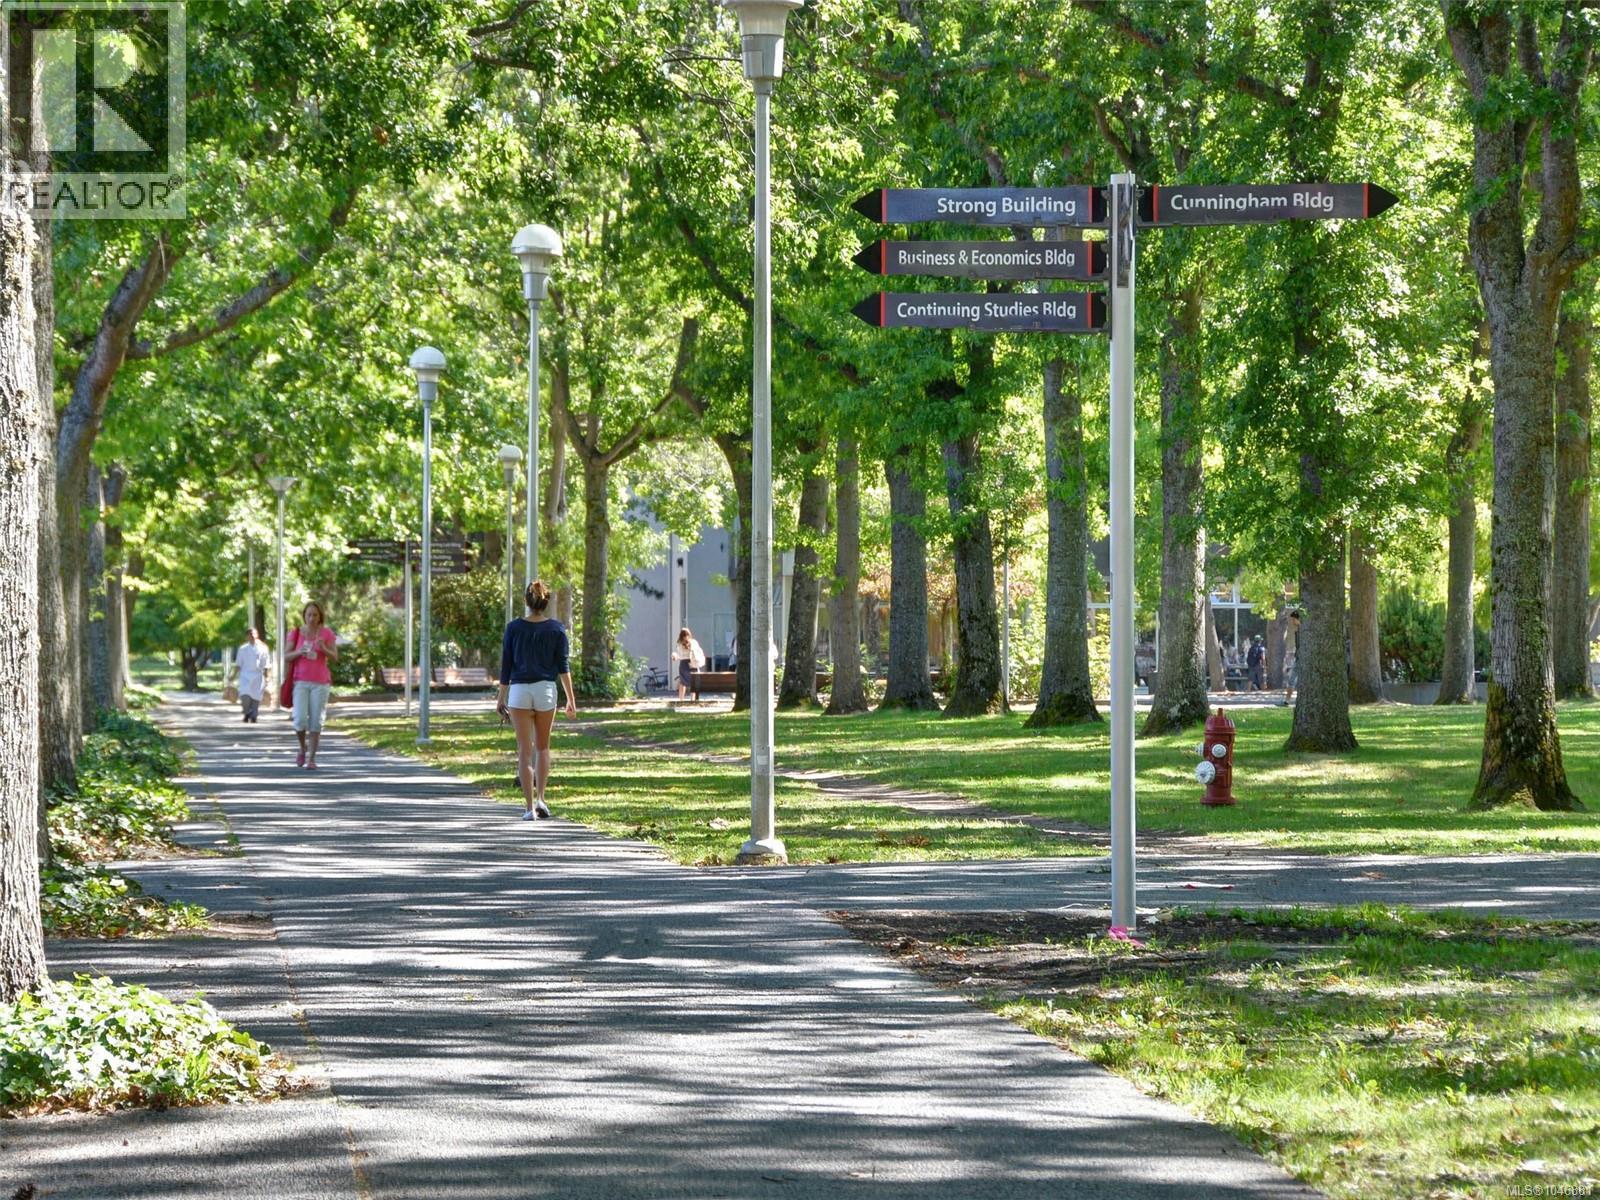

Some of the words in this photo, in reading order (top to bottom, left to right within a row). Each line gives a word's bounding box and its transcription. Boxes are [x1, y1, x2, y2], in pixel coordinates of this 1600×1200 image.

[937, 197, 997, 216] Strong
[1002, 196, 1076, 216] Building
[1170, 193, 1287, 212] Cunningham
[1293, 191, 1334, 212] Bldg
[898, 249, 955, 266] Business
[958, 249, 968, 265] &
[971, 249, 1042, 266] Economics
[1045, 248, 1075, 267] Bldg
[897, 301, 980, 321] Continuing
[984, 301, 1039, 318] Studies
[1042, 301, 1077, 319] Bldg
